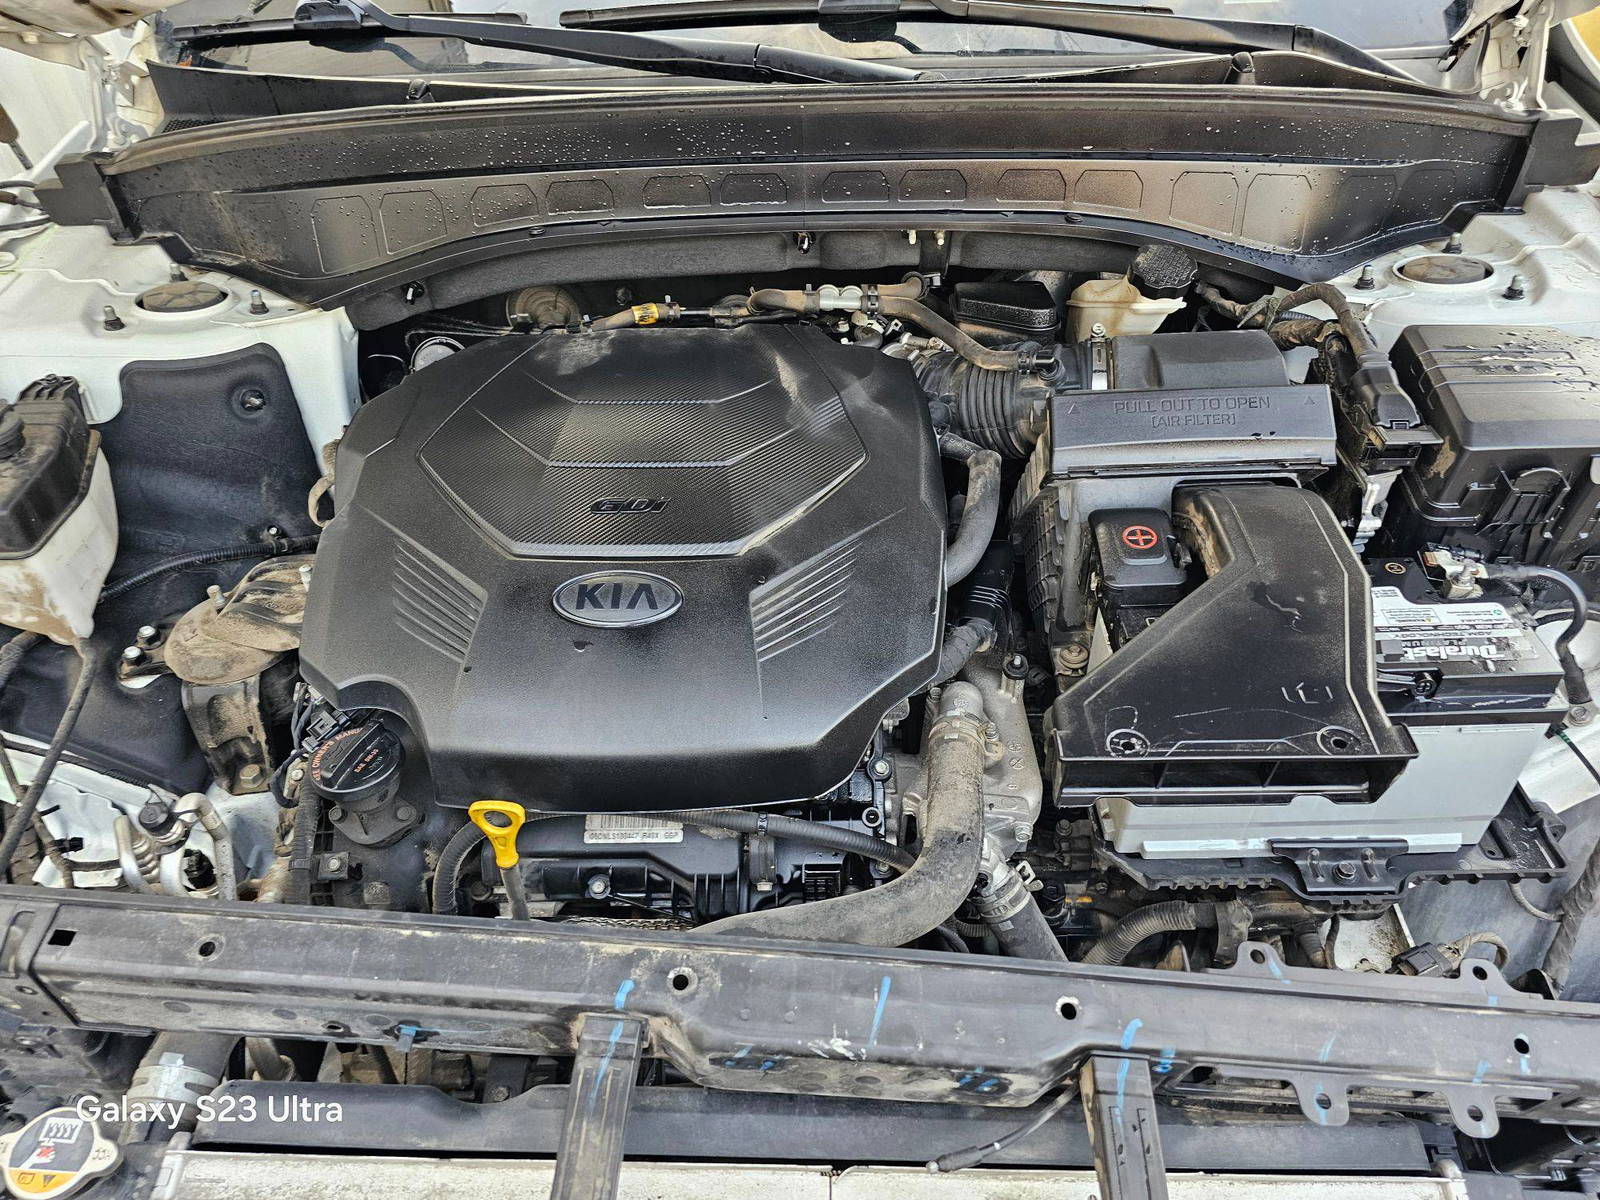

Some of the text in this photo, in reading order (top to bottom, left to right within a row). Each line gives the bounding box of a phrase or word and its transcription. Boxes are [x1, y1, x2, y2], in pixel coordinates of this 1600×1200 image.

[1113, 395, 1270, 414] PULL OUT TO OPEN
[575, 582, 659, 610] KIA
[1401, 639, 1467, 647] PLATINUM
[1402, 645, 1504, 660] Duralast
